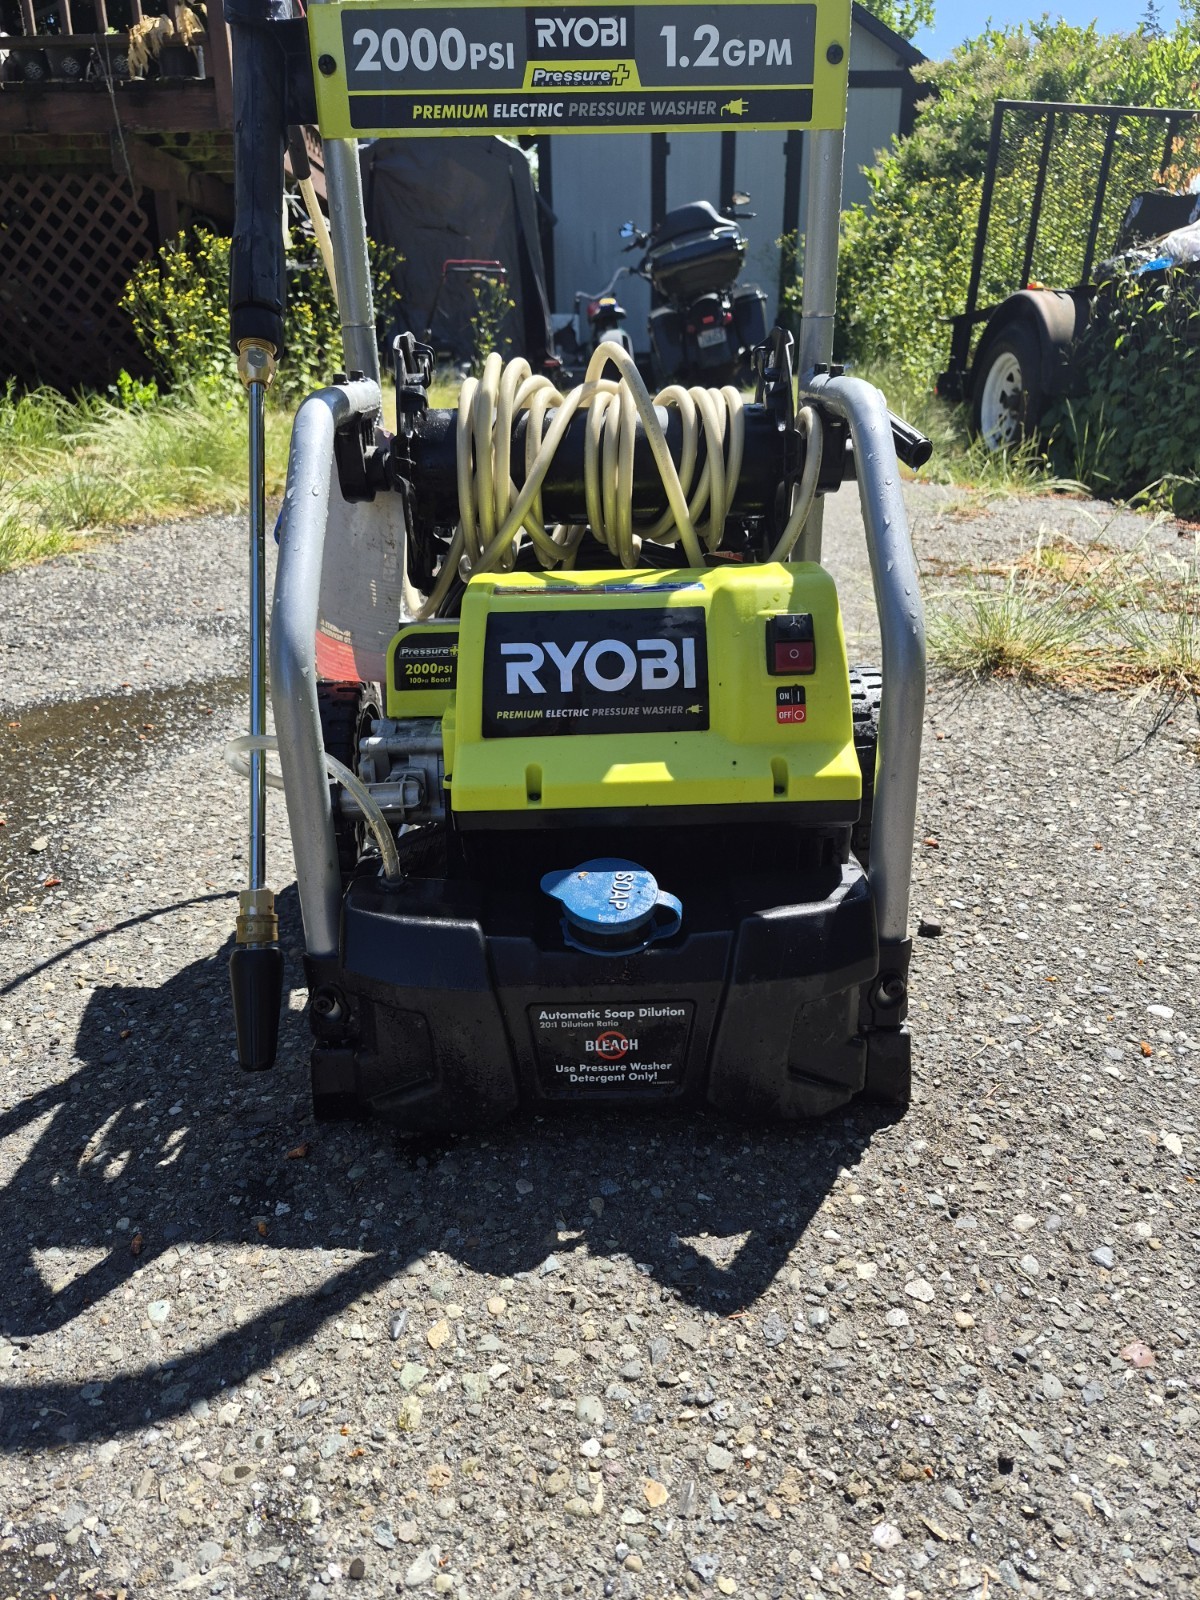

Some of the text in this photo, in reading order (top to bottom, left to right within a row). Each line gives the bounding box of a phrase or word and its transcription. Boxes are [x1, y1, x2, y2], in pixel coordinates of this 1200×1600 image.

[534, 17, 627, 48] RYOBI
[353, 27, 515, 72] 2000PSI
[412, 100, 717, 119] PREMIUM ELECTRIC PRESSURE WASHER
[405, 662, 453, 675] 2000PSI
[500, 637, 697, 695] RYOBI
[779, 692, 790, 700] ON
[496, 705, 684, 719] PREMIUM ELECTRIC PRESSURE WASHER
[778, 711, 792, 719] OFF
[609, 871, 635, 911] SOAP
[539, 1007, 686, 1020] Automatic Soap Dilution
[585, 1038, 639, 1052] BLEACH
[555, 1061, 672, 1073] Use Pressure Washer
[569, 1071, 658, 1084] Detergent Only!
